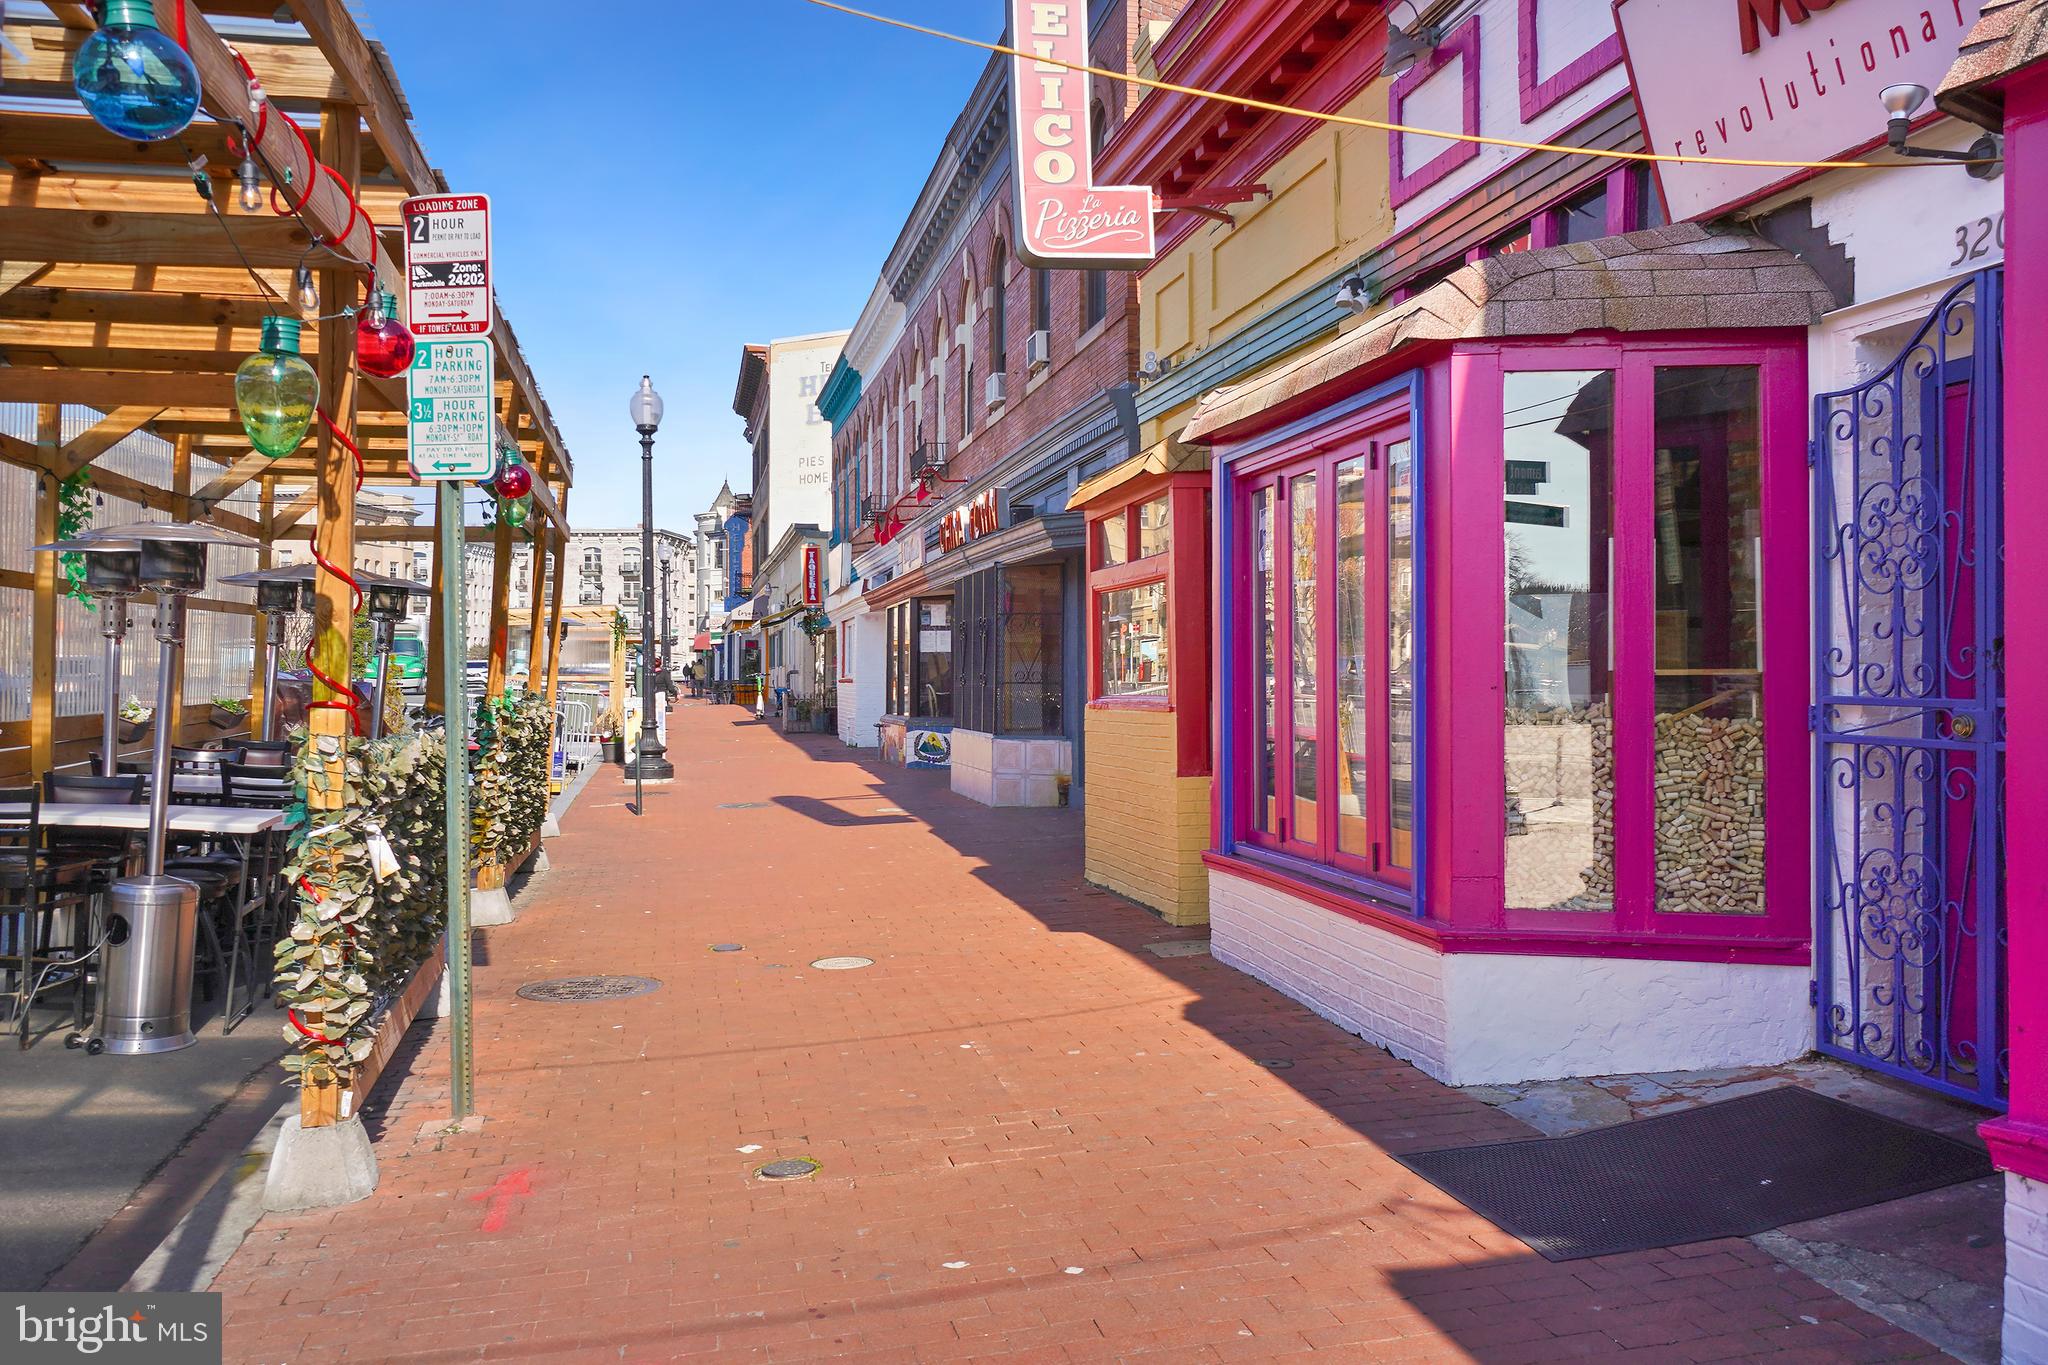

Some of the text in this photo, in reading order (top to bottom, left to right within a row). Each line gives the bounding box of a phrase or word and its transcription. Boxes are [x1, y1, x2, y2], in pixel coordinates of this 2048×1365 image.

[413, 199, 479, 212] LOADING ZONE
[1078, 194, 1102, 213] La
[432, 218, 464, 230] HOUR
[1034, 198, 1142, 240] Pizzeria
[413, 216, 425, 241] 2
[452, 263, 481, 273] Zone:
[412, 280, 446, 288] Parkmobile
[448, 273, 485, 286] 24202
[451, 323, 467, 332] CALL
[469, 323, 480, 331] 311
[417, 349, 427, 367] 2
[435, 347, 473, 358] HOUR
[435, 360, 482, 371] PARKING
[424, 385, 484, 395] MONDAY-SATURDAY
[443, 399, 475, 411] HOUR
[437, 411, 485, 422] PARKING
[425, 432, 483, 443] MONDAY-SARDAY
[798, 456, 825, 468] PIES
[799, 472, 829, 485] HOME
[808, 551, 817, 601] TAQUERIA
